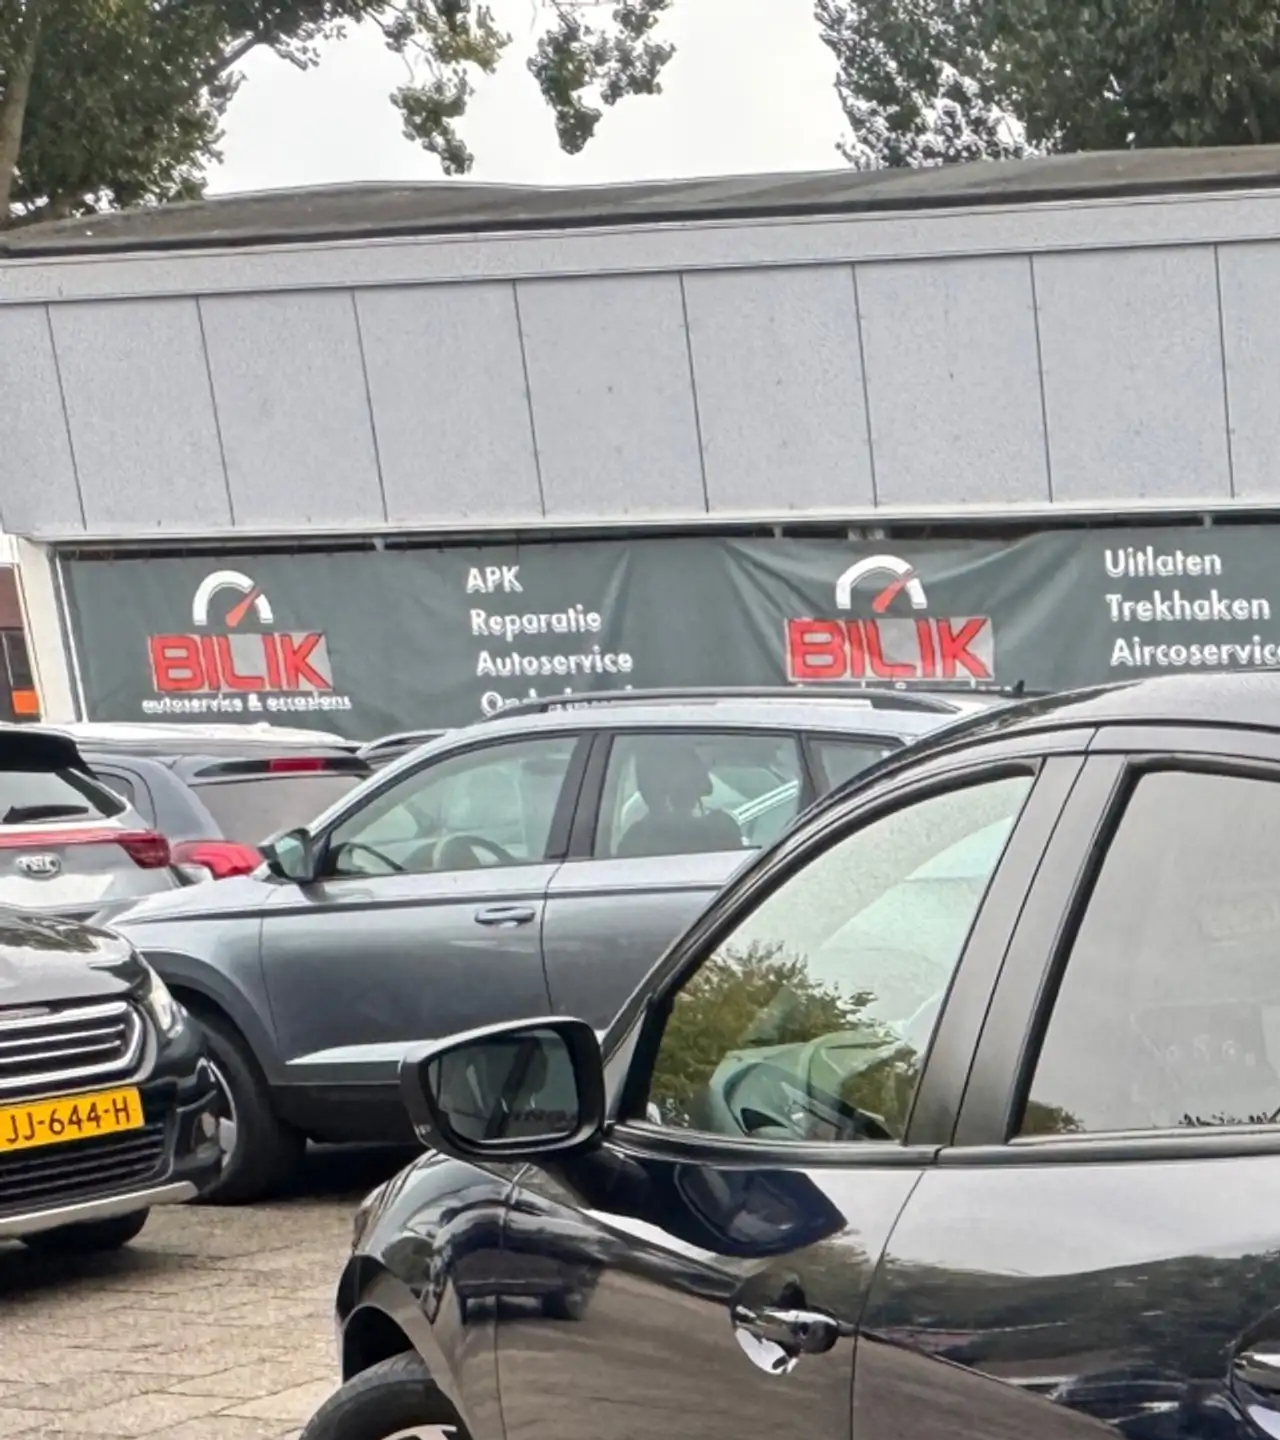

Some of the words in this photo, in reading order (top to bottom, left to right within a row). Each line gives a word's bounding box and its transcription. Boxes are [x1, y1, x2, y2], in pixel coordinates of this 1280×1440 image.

[1104, 546, 1222, 576] Uitlaten
[466, 565, 524, 593] APK
[1105, 589, 1271, 621] Trekhaken
[470, 604, 601, 641] Reparatie
[150, 632, 332, 691] BILIK
[476, 645, 633, 676] Autoservice
[788, 618, 992, 679] BILIK
[6, 1096, 130, 1144] JJ-644-H
